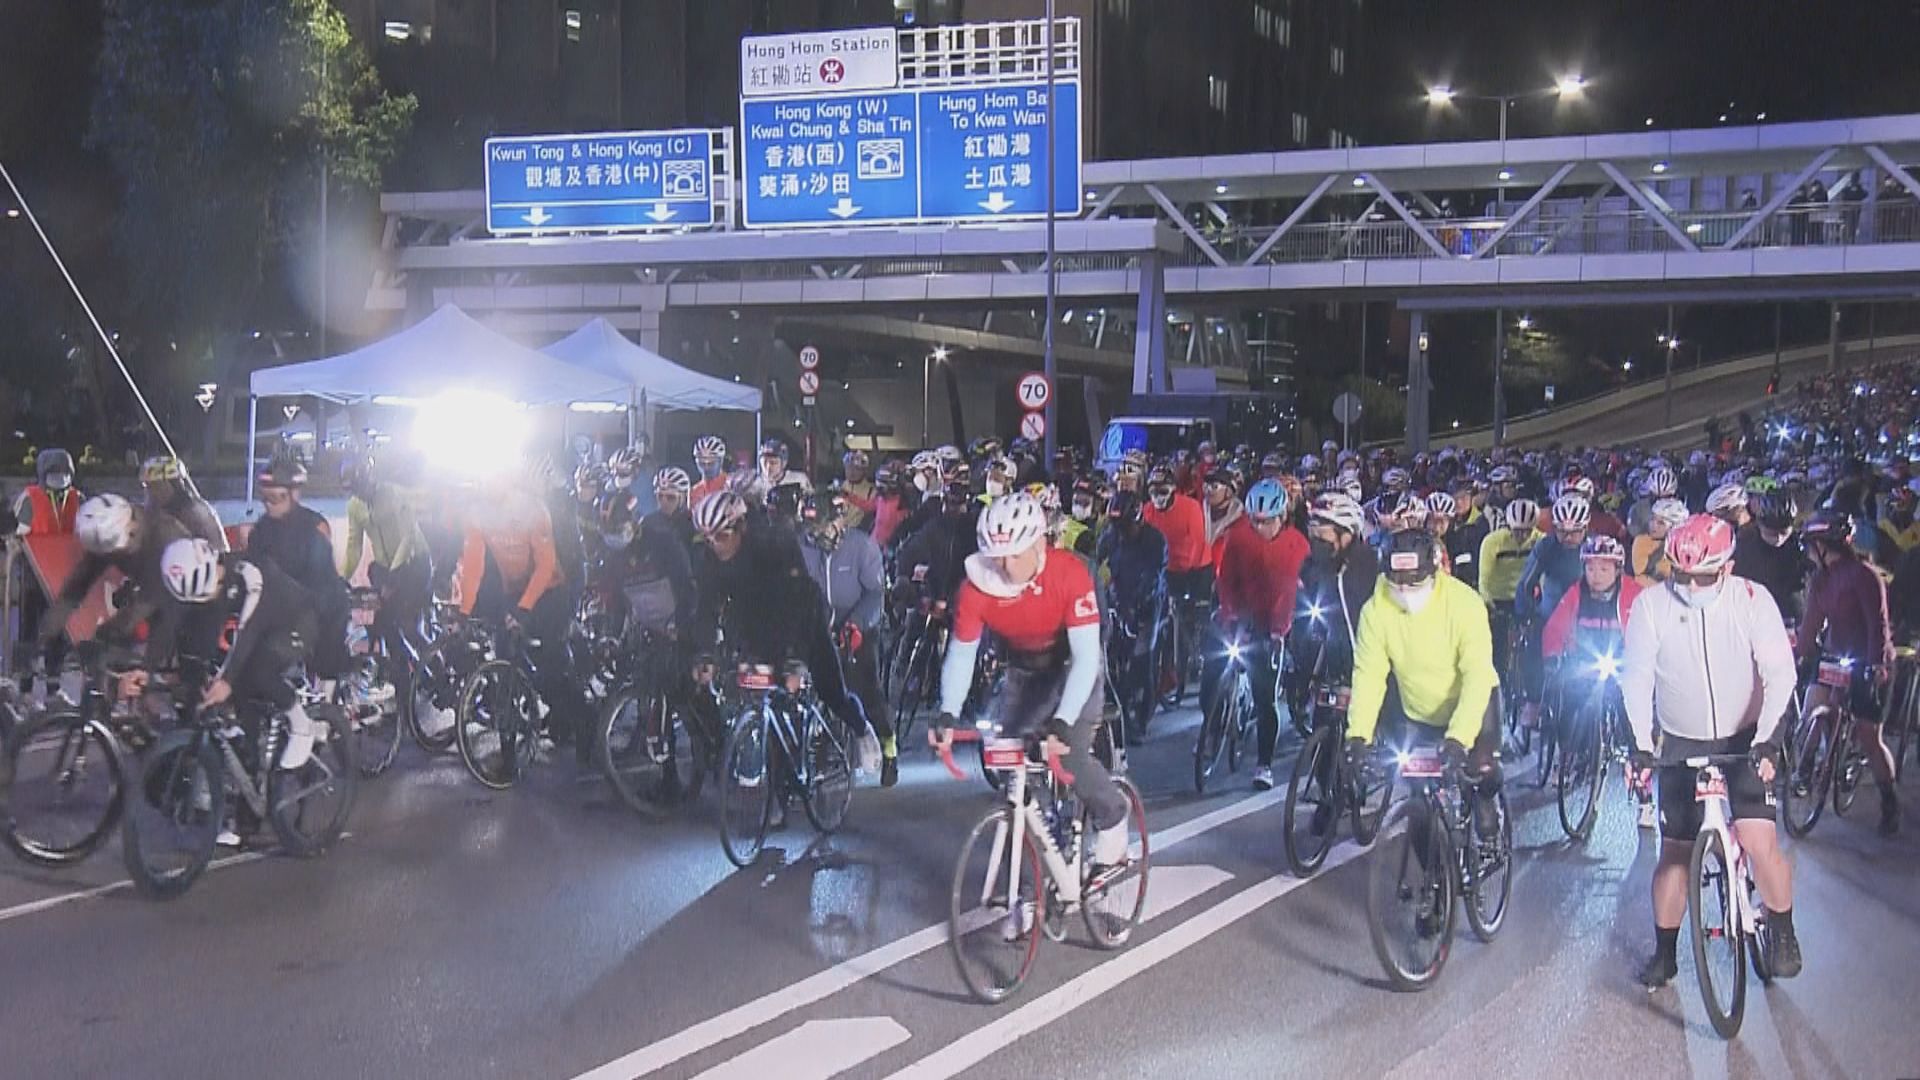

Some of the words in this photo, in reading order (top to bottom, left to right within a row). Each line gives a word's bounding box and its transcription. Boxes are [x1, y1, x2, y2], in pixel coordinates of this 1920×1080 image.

[792, 41, 824, 53] Hom
[832, 37, 890, 51] Station
[775, 104, 811, 121] Hong
[816, 102, 852, 119] Kong
[857, 98, 888, 116] (W)
[939, 95, 977, 112] Hung
[984, 92, 1018, 108] Hom
[751, 124, 784, 139] Kwai
[789, 122, 833, 139] Chung
[839, 118, 850, 135] &
[857, 118, 884, 134] Sha
[889, 116, 912, 132] Tin
[950, 113, 969, 130] To
[974, 112, 1006, 128] Kwa
[1013, 110, 1046, 126] Wan
[491, 145, 526, 161] Kwun
[531, 143, 564, 161] Tong
[571, 143, 582, 157] &
[588, 141, 623, 158] Hong
[628, 139, 662, 155] Kong
[667, 136, 692, 153] (C)
[964, 132, 1030, 159] 紅磡灣
[525, 161, 659, 188] 觀塘及香港(中)
[964, 162, 1031, 190] 土瓜灣
[802, 352, 816, 363] 70
[1022, 382, 1046, 399] 70
